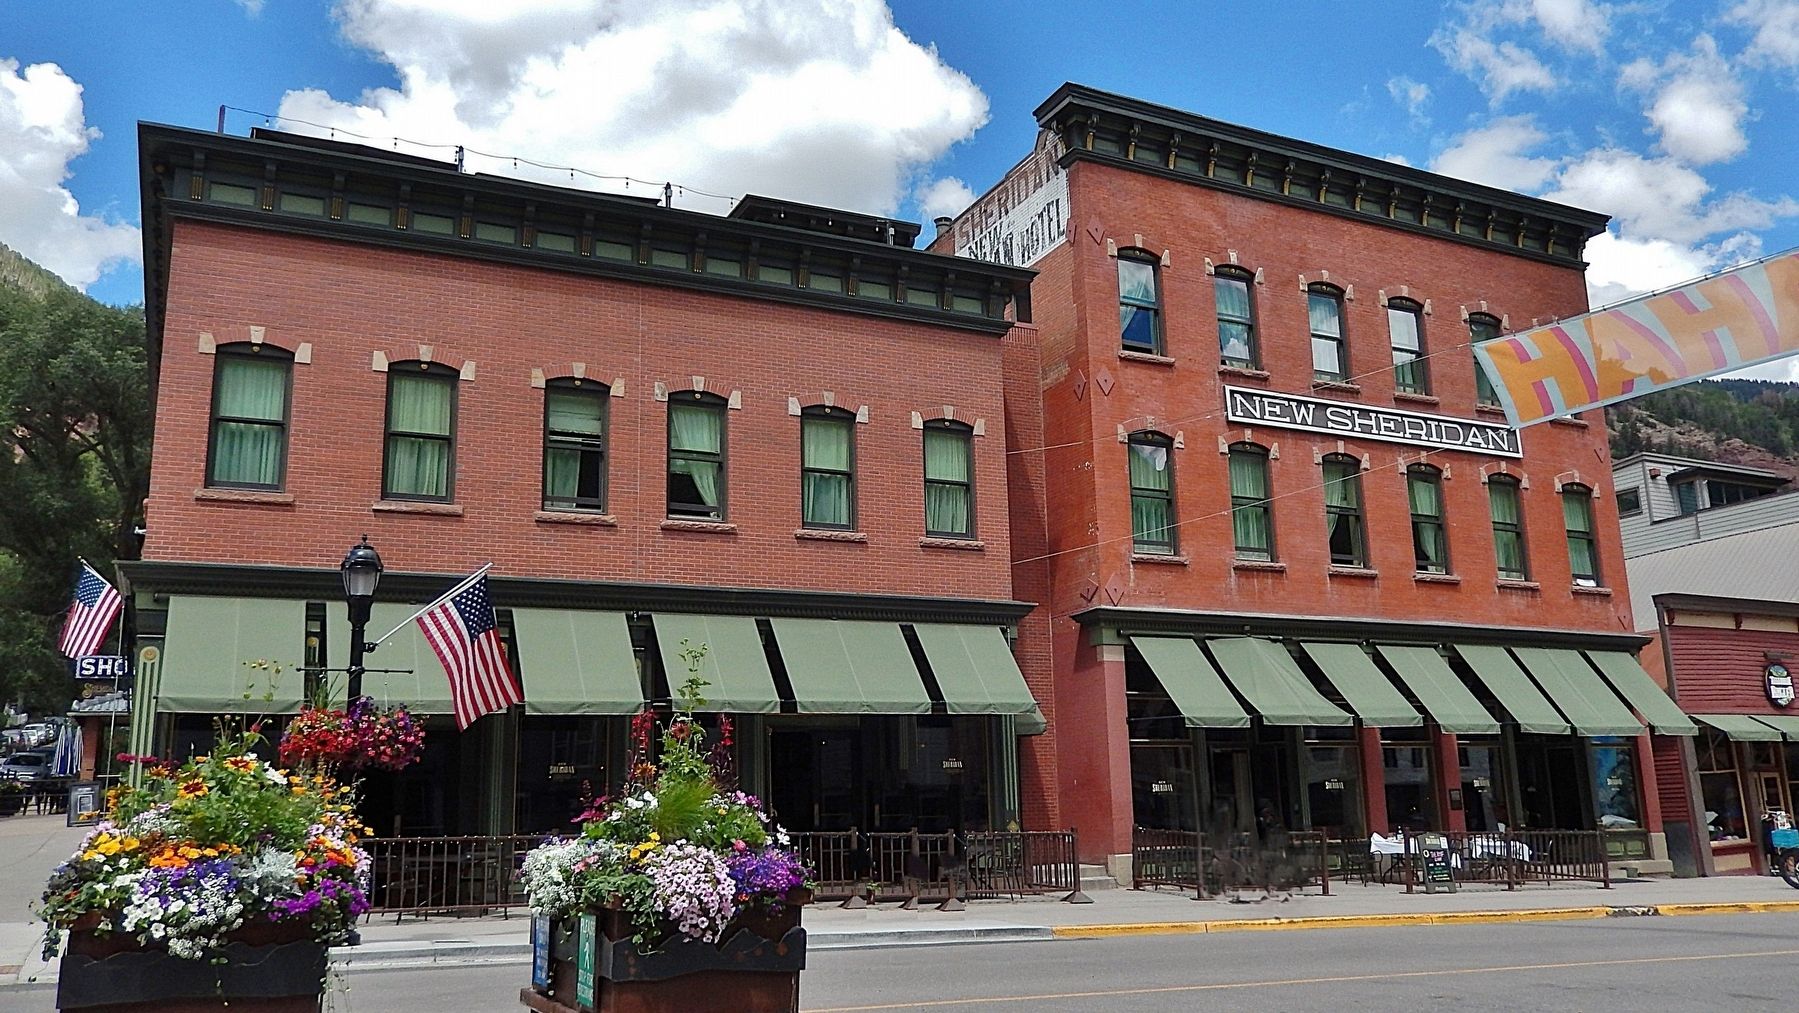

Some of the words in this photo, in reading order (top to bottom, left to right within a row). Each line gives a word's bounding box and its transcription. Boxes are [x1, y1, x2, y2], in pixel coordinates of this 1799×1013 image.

[958, 143, 1061, 249] SHERIDAN
[1233, 393, 1316, 425] NEW
[81, 658, 135, 675] SHO
